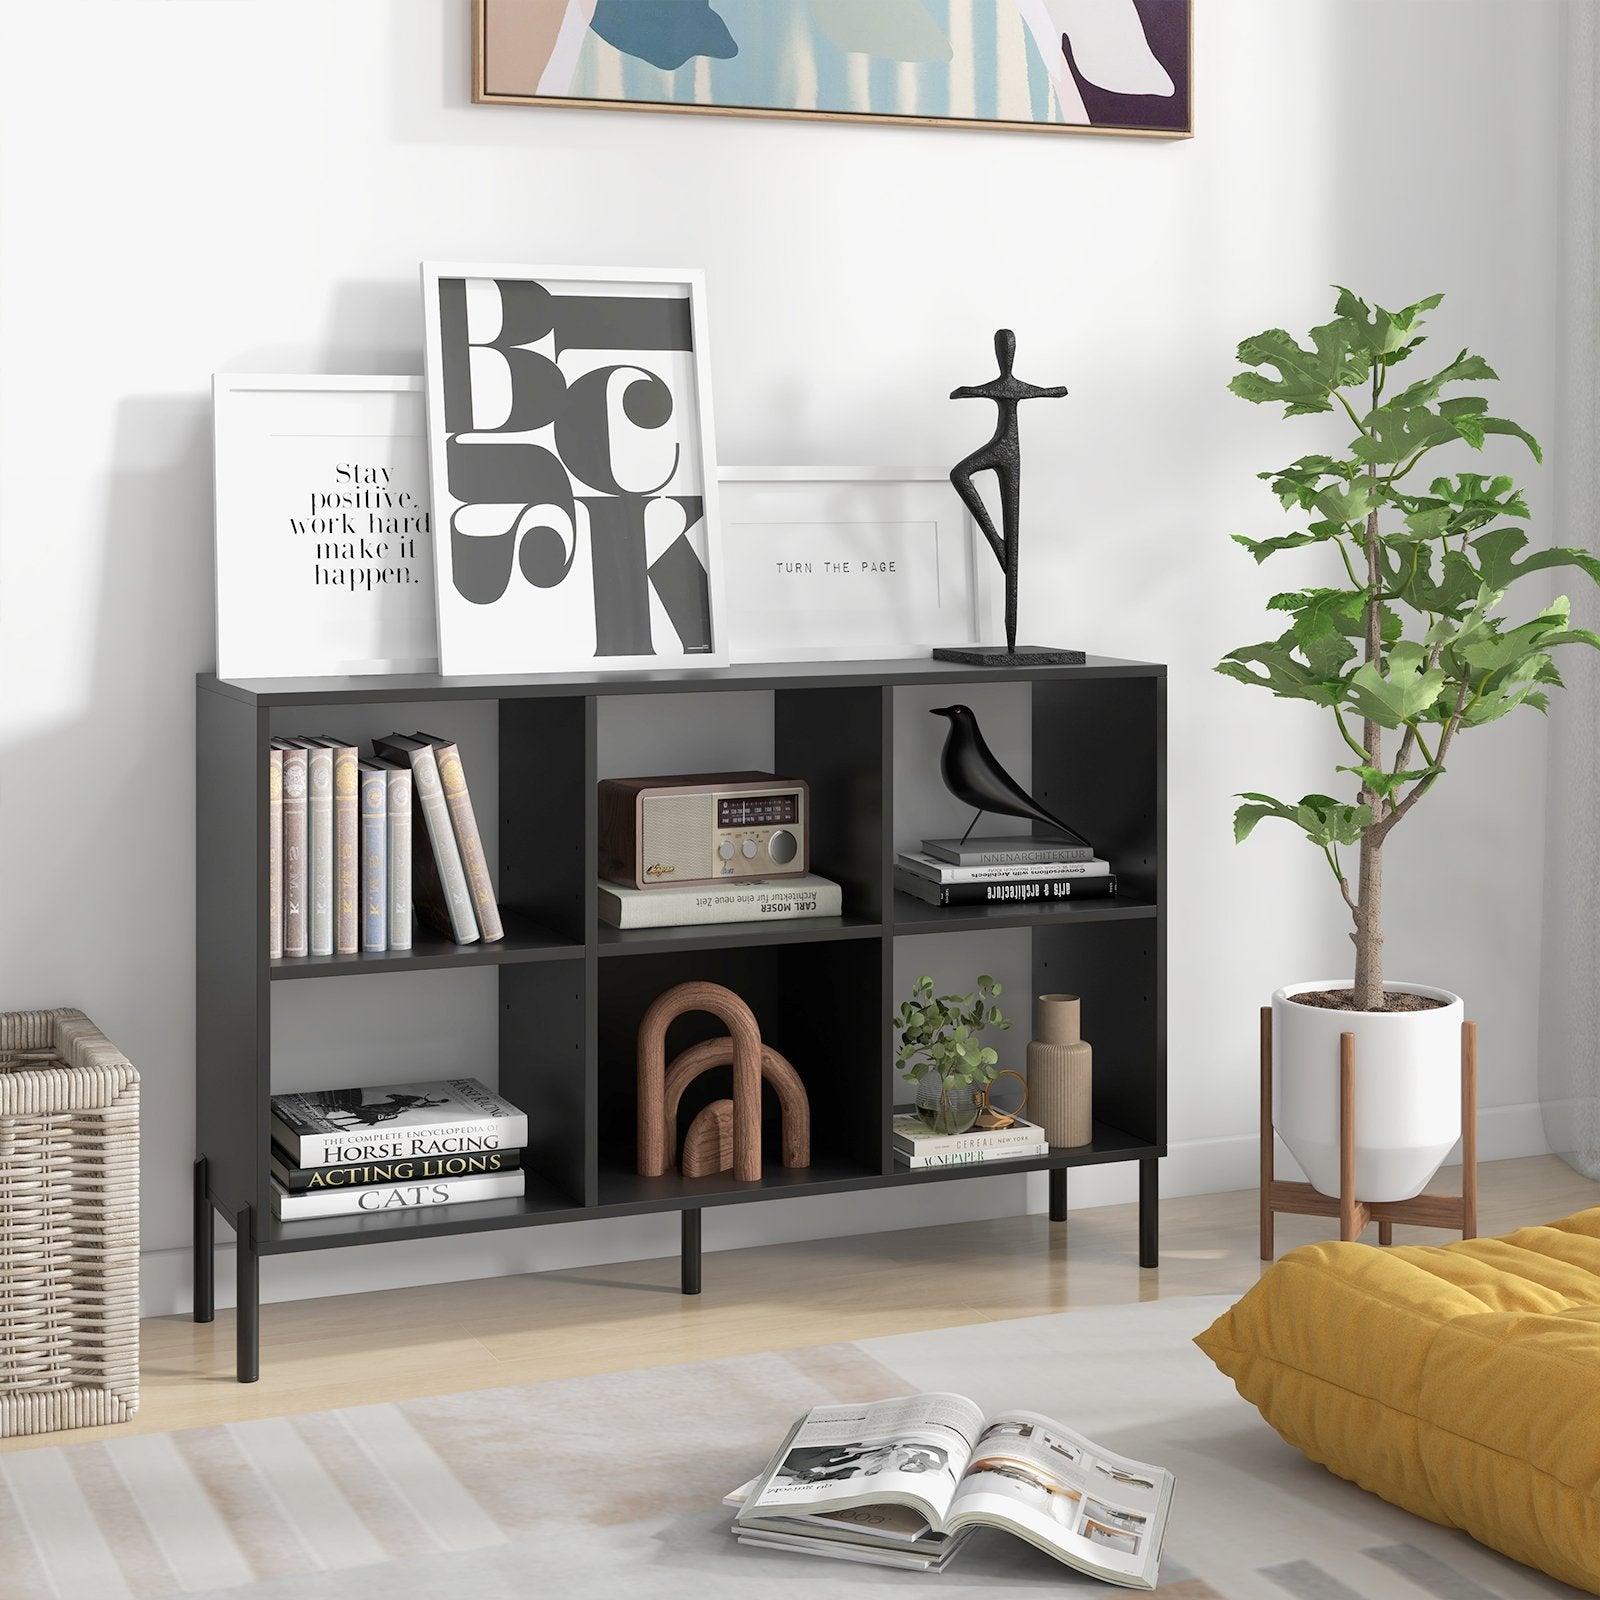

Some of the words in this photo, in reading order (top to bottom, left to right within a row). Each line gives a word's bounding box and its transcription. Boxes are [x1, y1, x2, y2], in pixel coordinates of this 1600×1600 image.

[336, 463, 394, 490] Stay
[311, 486, 419, 516] positive,
[290, 513, 355, 534] work
[369, 512, 430, 533] hard
[317, 538, 389, 559] make
[401, 536, 417, 558] it
[776, 562, 812, 573] TURN
[824, 561, 850, 573] THE
[861, 561, 896, 573] PAGE
[315, 564, 419, 591] happen.
[980, 850, 1086, 863] INNENARCHITEKTUR
[1031, 868, 1086, 876] Conversations
[772, 891, 817, 902] Architektur
[987, 885, 1040, 900] architecture
[1054, 883, 1071, 897] arts
[696, 897, 712, 907] Zeit
[715, 896, 735, 904] neue
[737, 895, 754, 905] eine
[757, 894, 769, 903] für
[761, 903, 791, 913] MOSER
[795, 901, 817, 911] CARL
[323, 1137, 344, 1146] THE
[347, 1132, 403, 1144] COMPLETE
[407, 1125, 484, 1139] ENCYCLOPEDIA
[323, 1143, 403, 1164] HORSE
[411, 1135, 500, 1156] RACING
[957, 1138, 993, 1149] CEREAL
[307, 1163, 414, 1188] ACTING
[423, 1154, 501, 1177] LIONS
[358, 1184, 450, 1210] CATS
